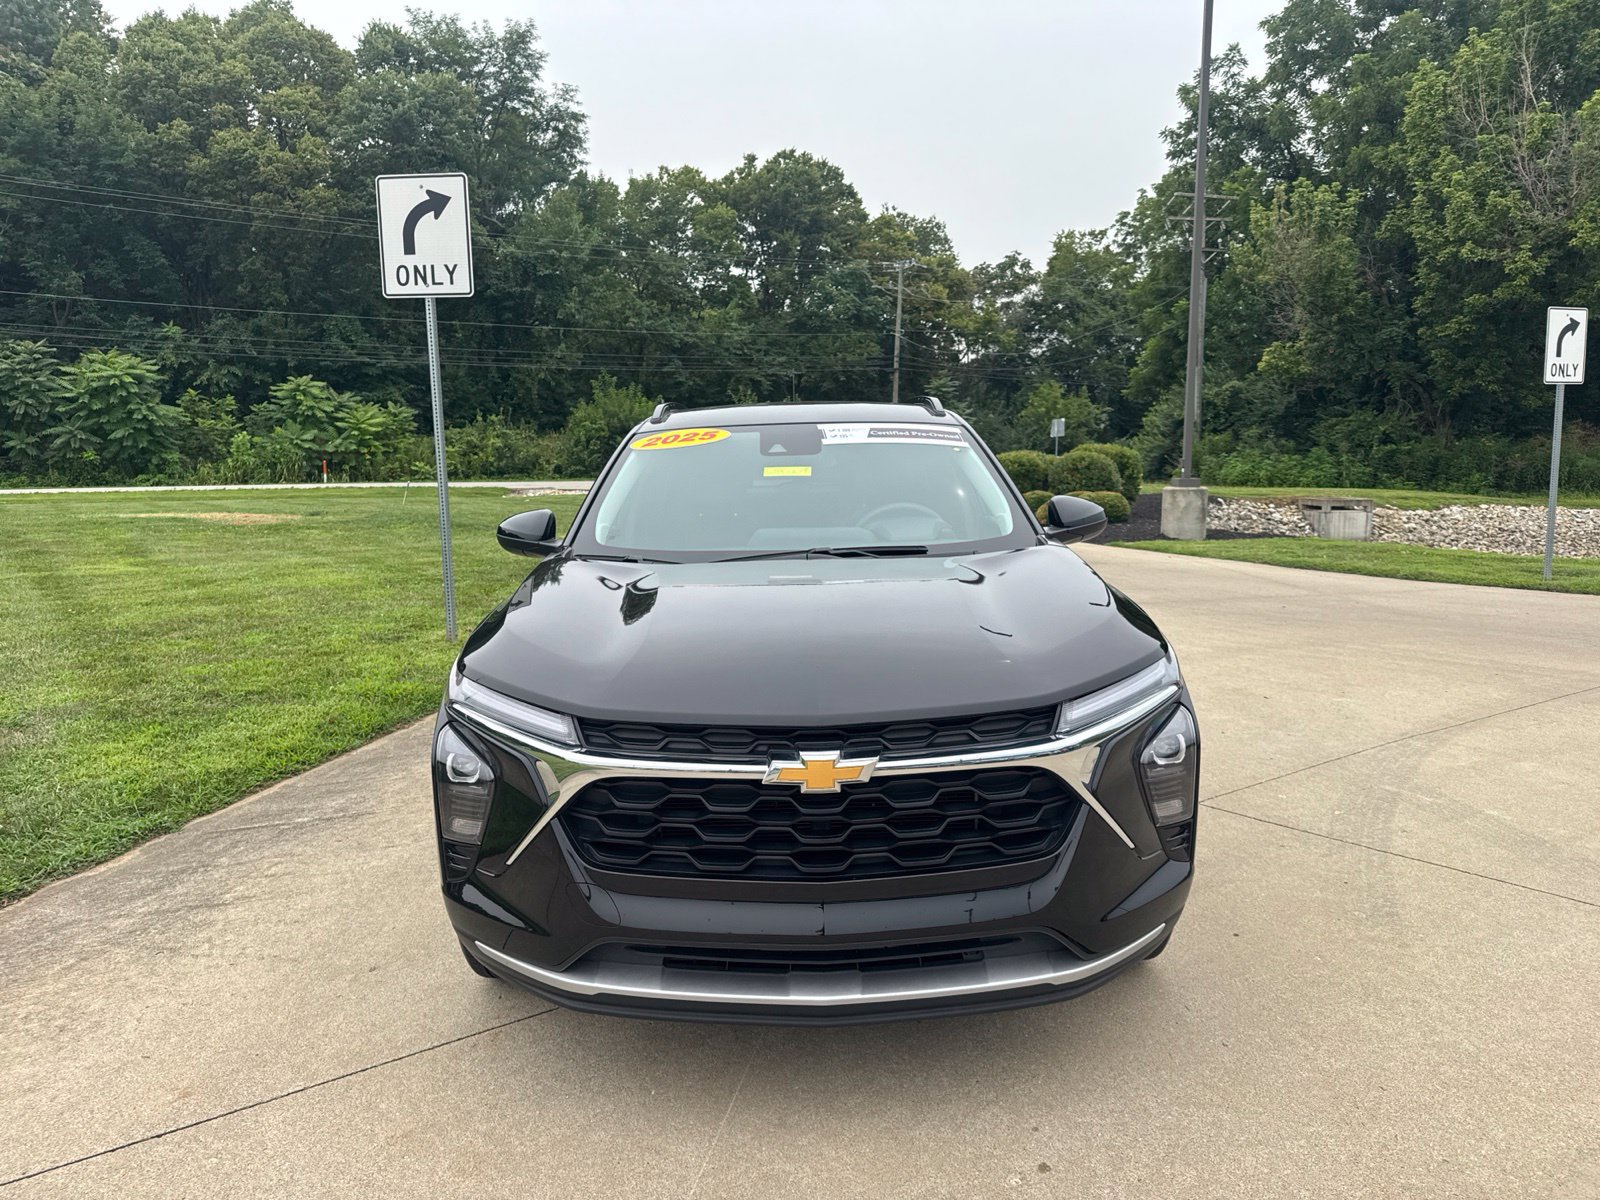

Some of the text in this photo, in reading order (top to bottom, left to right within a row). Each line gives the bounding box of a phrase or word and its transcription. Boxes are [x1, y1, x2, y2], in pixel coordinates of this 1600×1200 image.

[396, 264, 458, 287] ONLY
[1551, 363, 1579, 377] ONLY
[640, 431, 720, 448] 2025
[910, 430, 960, 439] Pre-Owned
